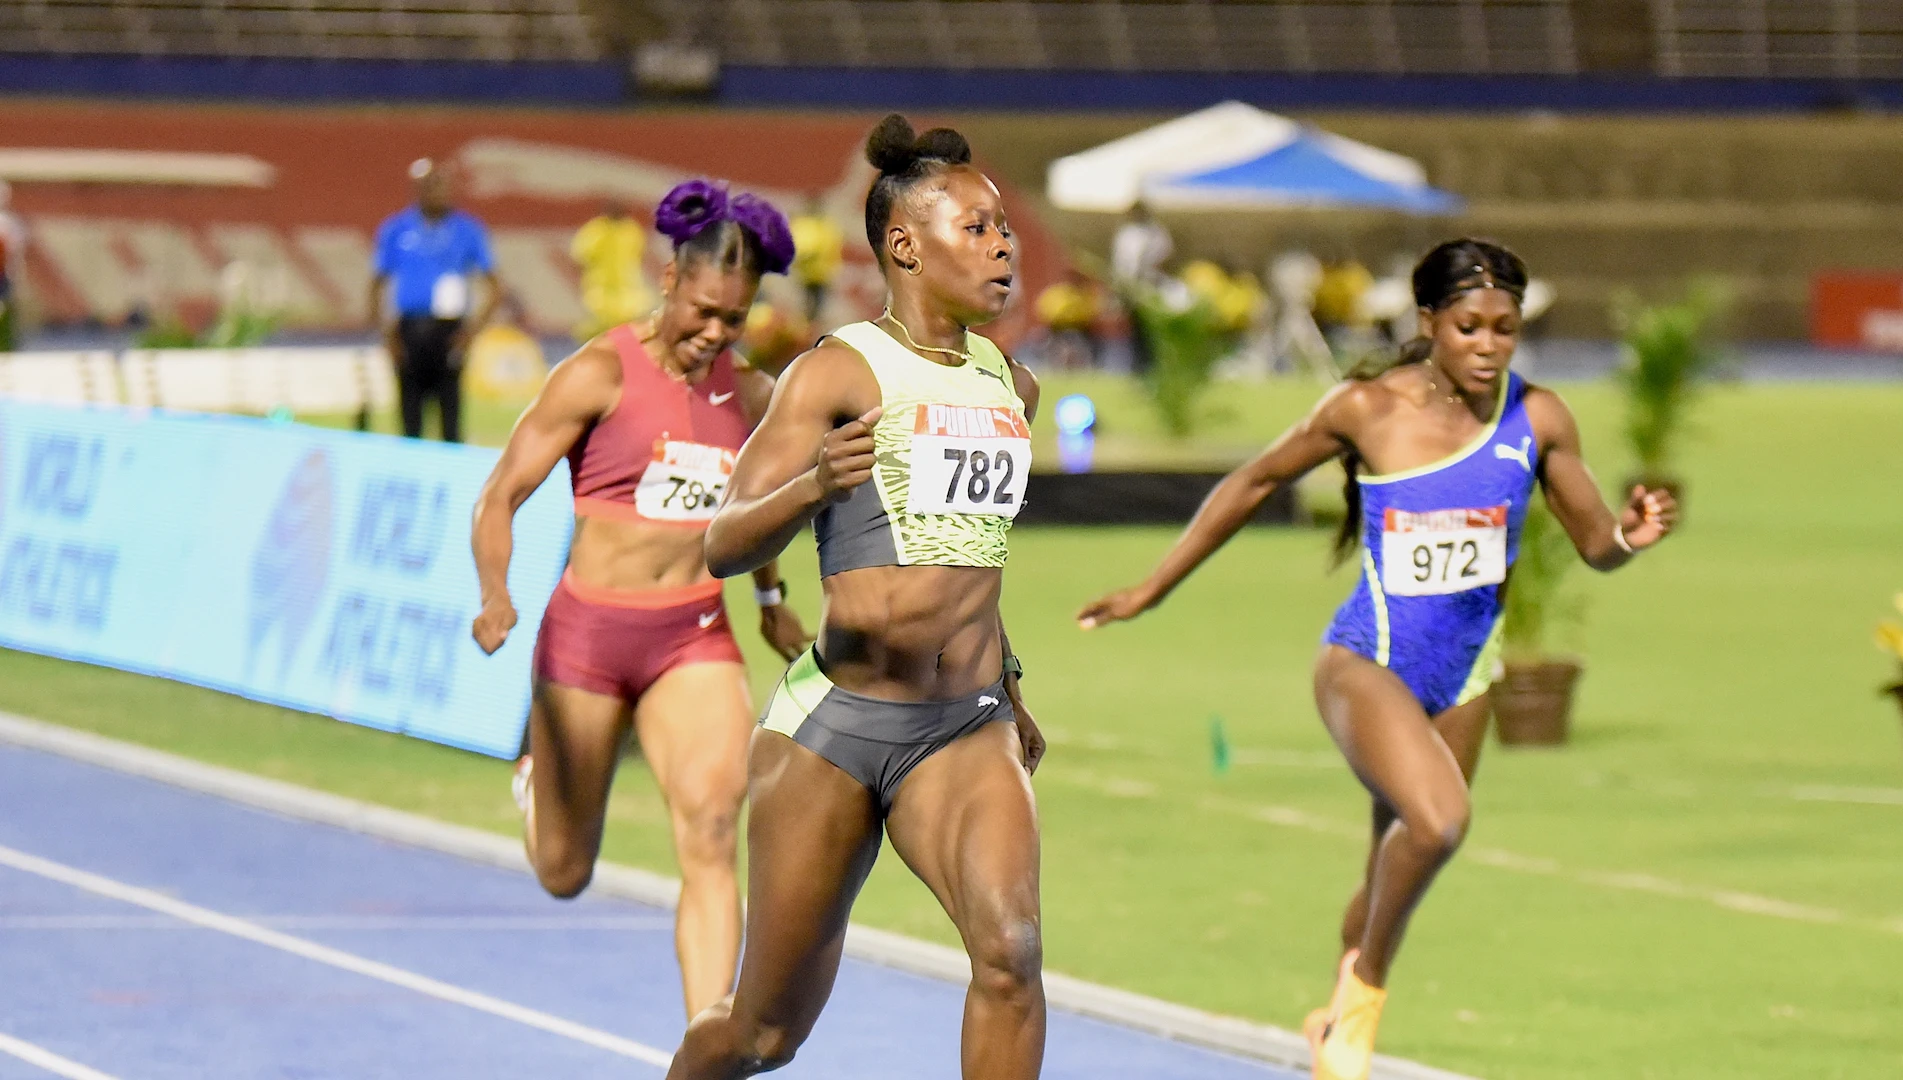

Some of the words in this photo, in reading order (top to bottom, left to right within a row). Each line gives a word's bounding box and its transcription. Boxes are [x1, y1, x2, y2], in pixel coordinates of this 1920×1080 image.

[928, 404, 997, 437] PUMA
[944, 448, 1014, 504] 782
[1412, 540, 1479, 583] 972
